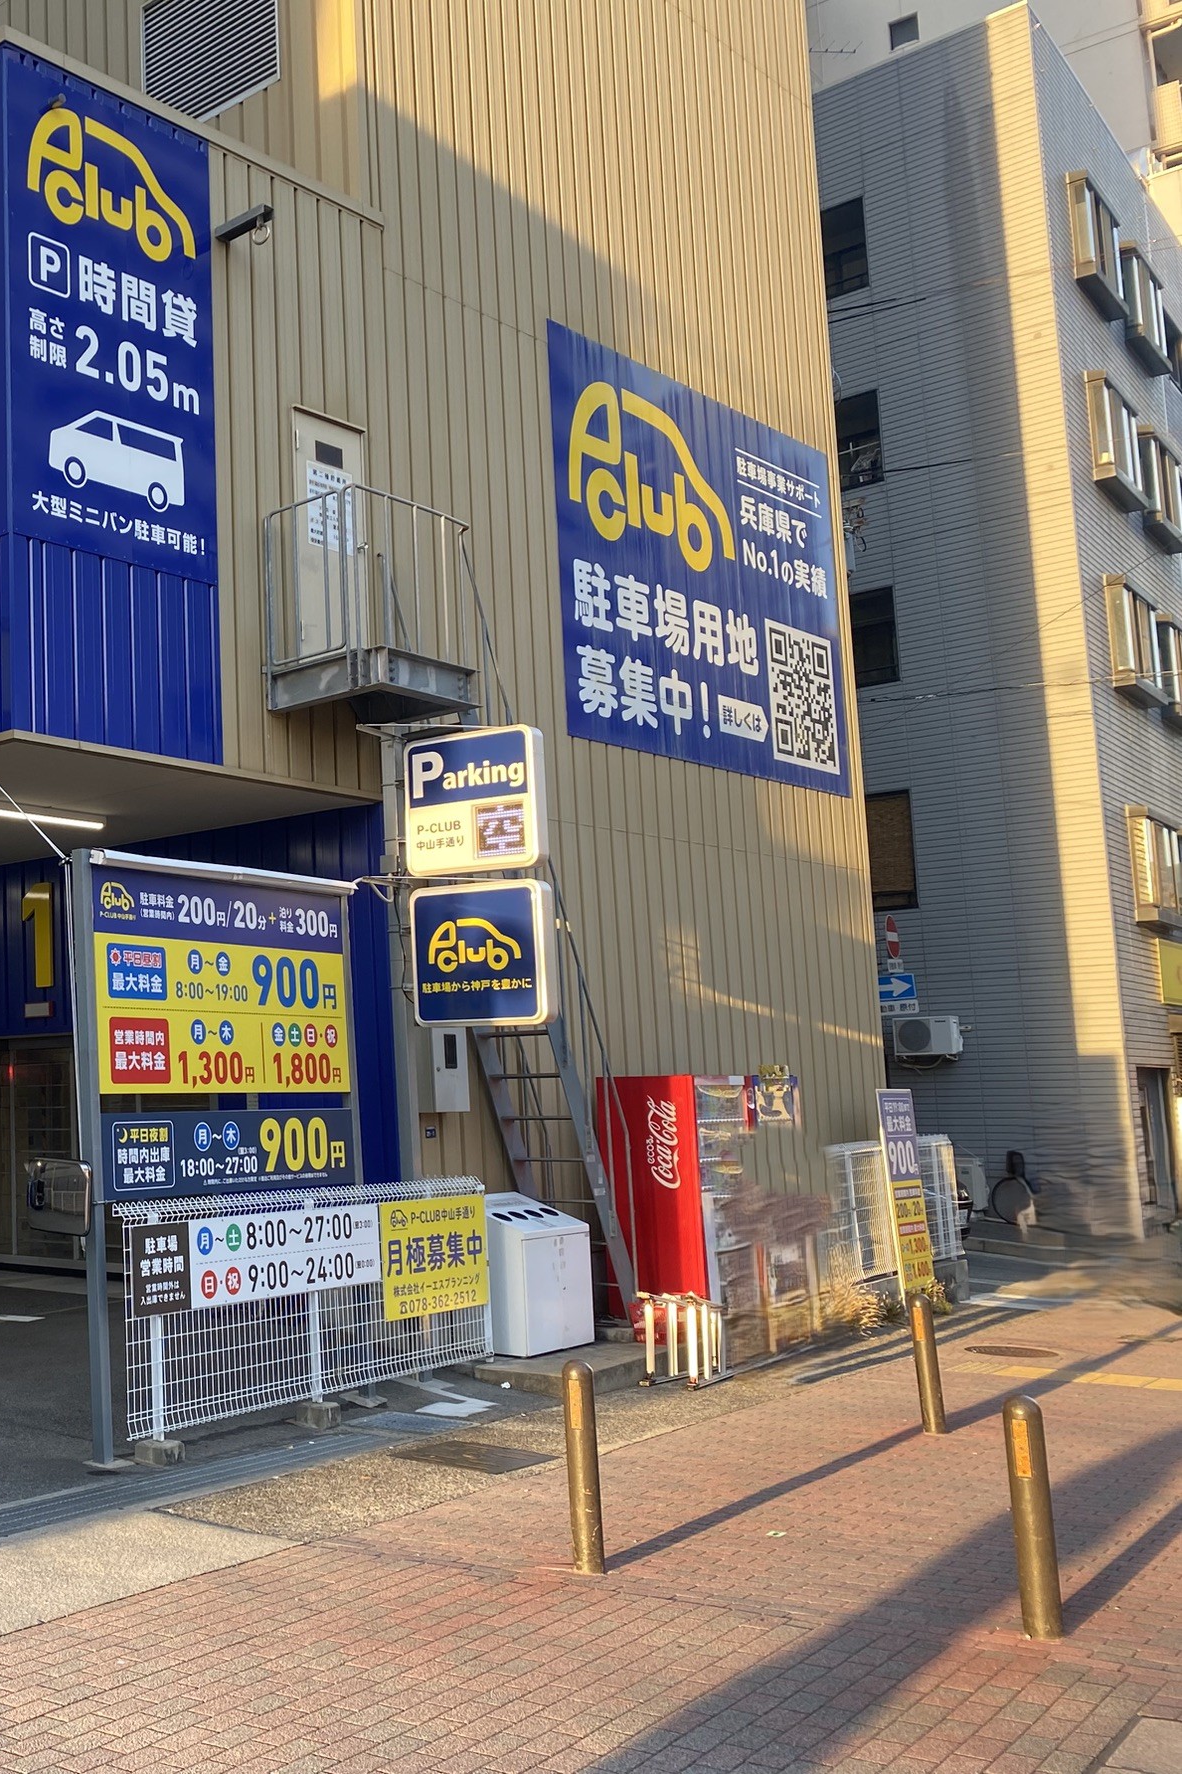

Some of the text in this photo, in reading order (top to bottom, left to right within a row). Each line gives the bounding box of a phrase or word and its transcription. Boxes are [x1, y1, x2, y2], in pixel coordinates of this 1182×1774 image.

[39, 245, 62, 283] P
[78, 254, 198, 348] 時間貸
[29, 307, 66, 341] 高さ
[29, 334, 67, 370] 制限
[76, 325, 201, 416] 2.05m
[736, 455, 822, 508] 駐車場事業サポート
[32, 490, 206, 557] 大型ミニバン駐車可能!
[739, 495, 808, 550] 兵庫県で
[743, 539, 828, 600] No.1の実績
[573, 558, 759, 677] 駐車場用地
[576, 644, 712, 739] 募集中!
[722, 704, 763, 733] 詳しくは
[412, 751, 524, 799] Parking
[416, 834, 464, 851] 中山手通り
[417, 820, 462, 835] P-CLUB
[139, 892, 174, 909] 駐車料金
[22, 882, 53, 988] 1
[295, 908, 338, 939] 300円
[112, 972, 163, 993] 最大料金
[252, 954, 337, 1010] 900円
[114, 1029, 165, 1046] 営業時間内
[114, 1051, 166, 1072] 最大料金
[178, 1051, 255, 1088] 1,300円
[273, 1053, 341, 1088] 1,800円
[129, 1126, 168, 1143] 平日夜割
[259, 1117, 346, 1173] 900円
[117, 1146, 170, 1164] 時間内出庫
[123, 1167, 166, 1184] 最大料金
[144, 1235, 178, 1255] 駐車場
[387, 1229, 482, 1277] 月極募集中
[140, 1255, 184, 1277] 営業時間
